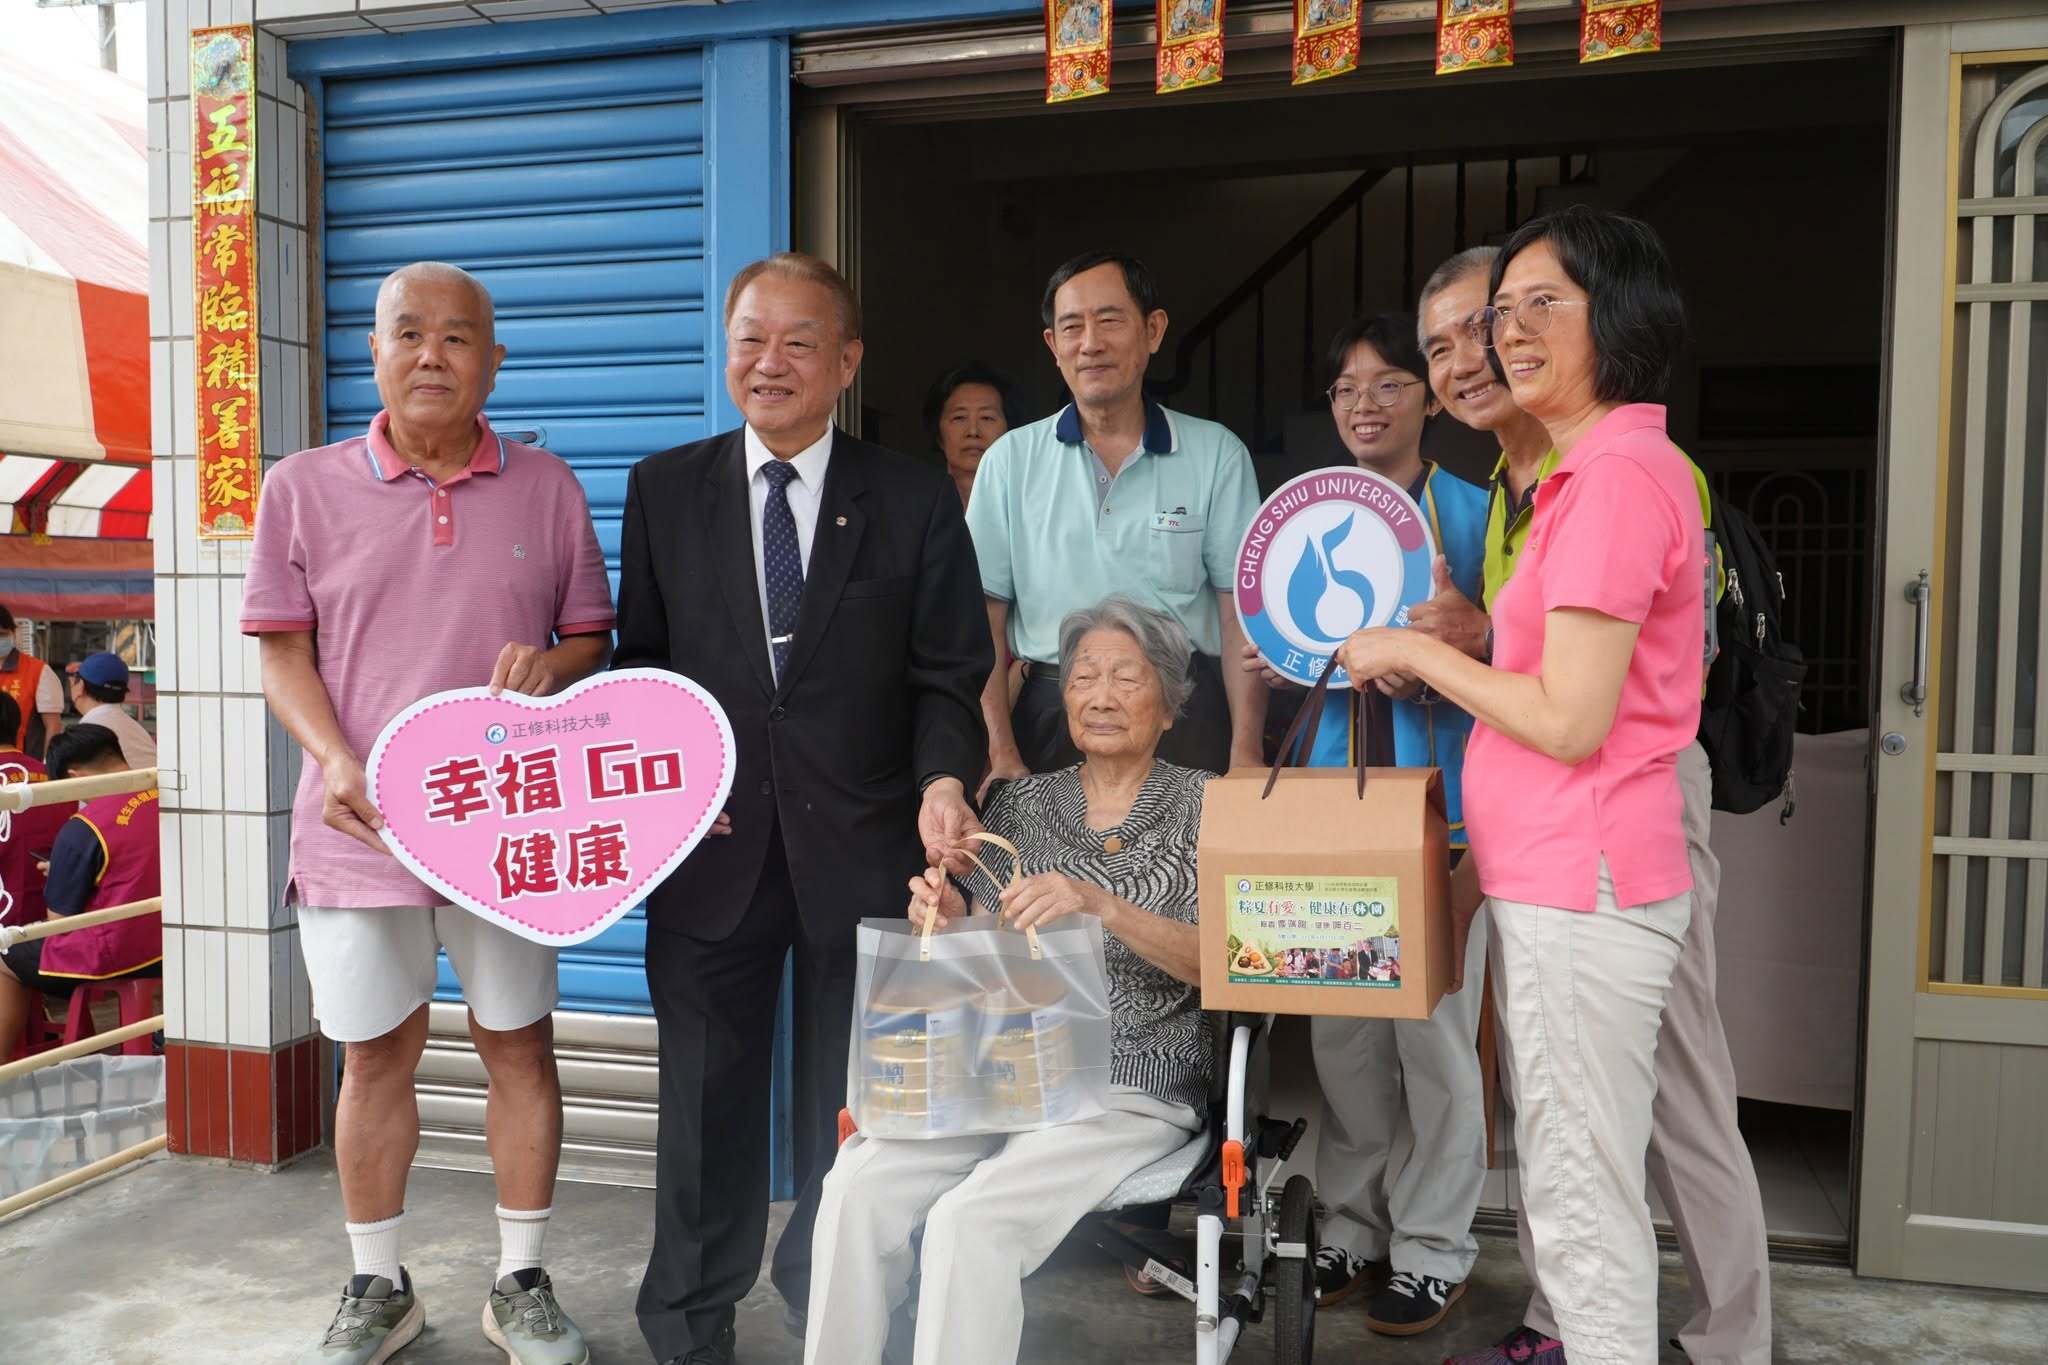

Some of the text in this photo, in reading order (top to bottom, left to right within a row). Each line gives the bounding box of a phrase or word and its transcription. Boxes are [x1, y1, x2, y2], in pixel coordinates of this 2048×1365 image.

[201, 106, 250, 509] 五福常臨積善家
[1241, 478, 1412, 589] CHENG SHIU UNIVERSITY
[512, 713, 611, 738] 正修科技大學
[426, 743, 682, 823] 幸福 Go
[493, 823, 629, 899] 健康
[1255, 881, 1315, 892] 正修科技大學
